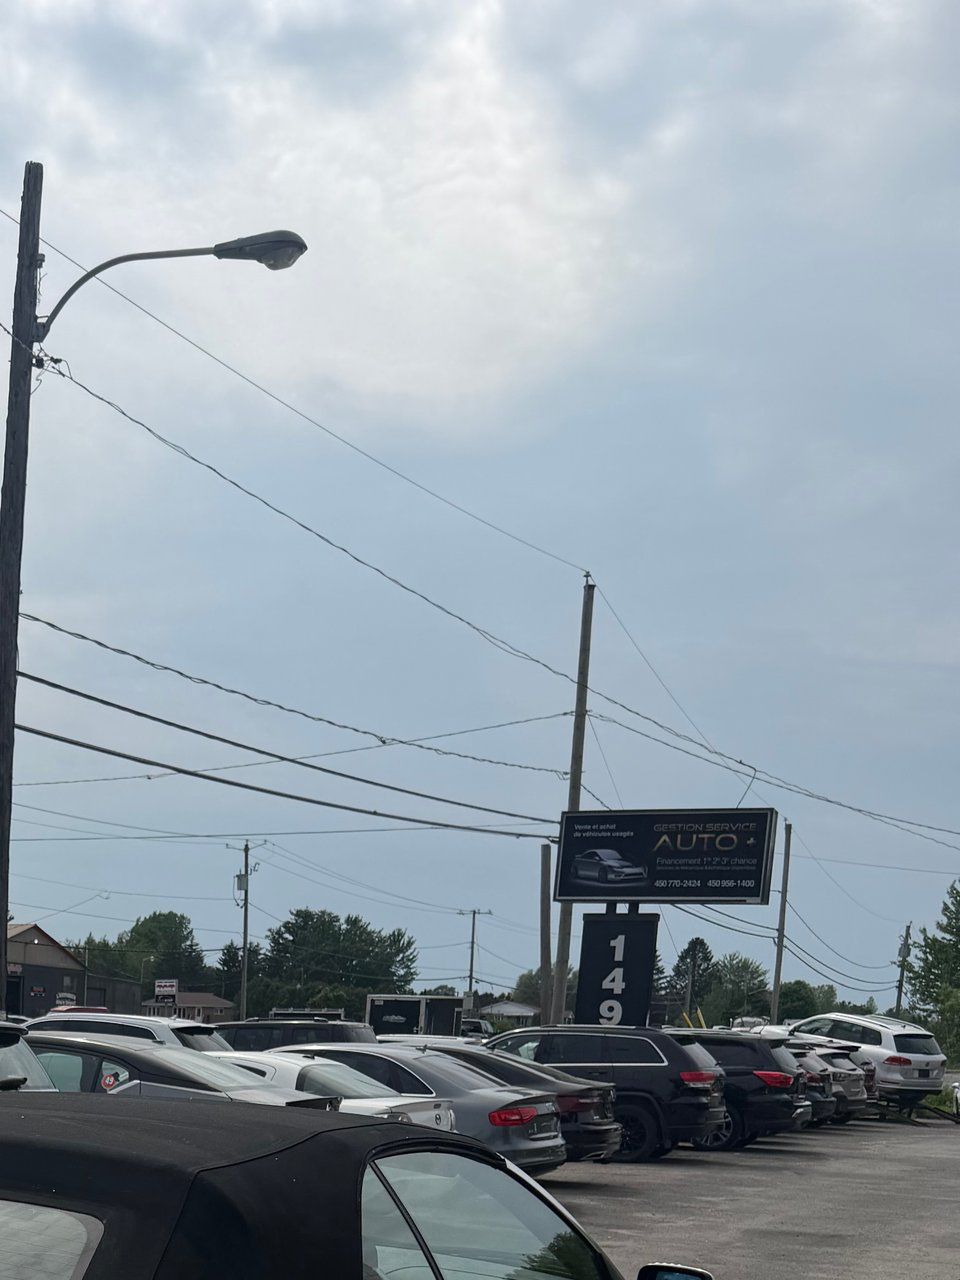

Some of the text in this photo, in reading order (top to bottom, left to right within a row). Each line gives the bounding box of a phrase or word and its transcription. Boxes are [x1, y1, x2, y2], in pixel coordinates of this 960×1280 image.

[653, 823, 757, 832] GESTION SERVICE
[652, 834, 738, 851] AUTO
[656, 857, 701, 865] Financement
[730, 857, 758, 865] chance
[654, 880, 667, 888] 450
[668, 880, 701, 888] 770-2424
[707, 880, 720, 888] 450
[599, 934, 626, 1026] 149
